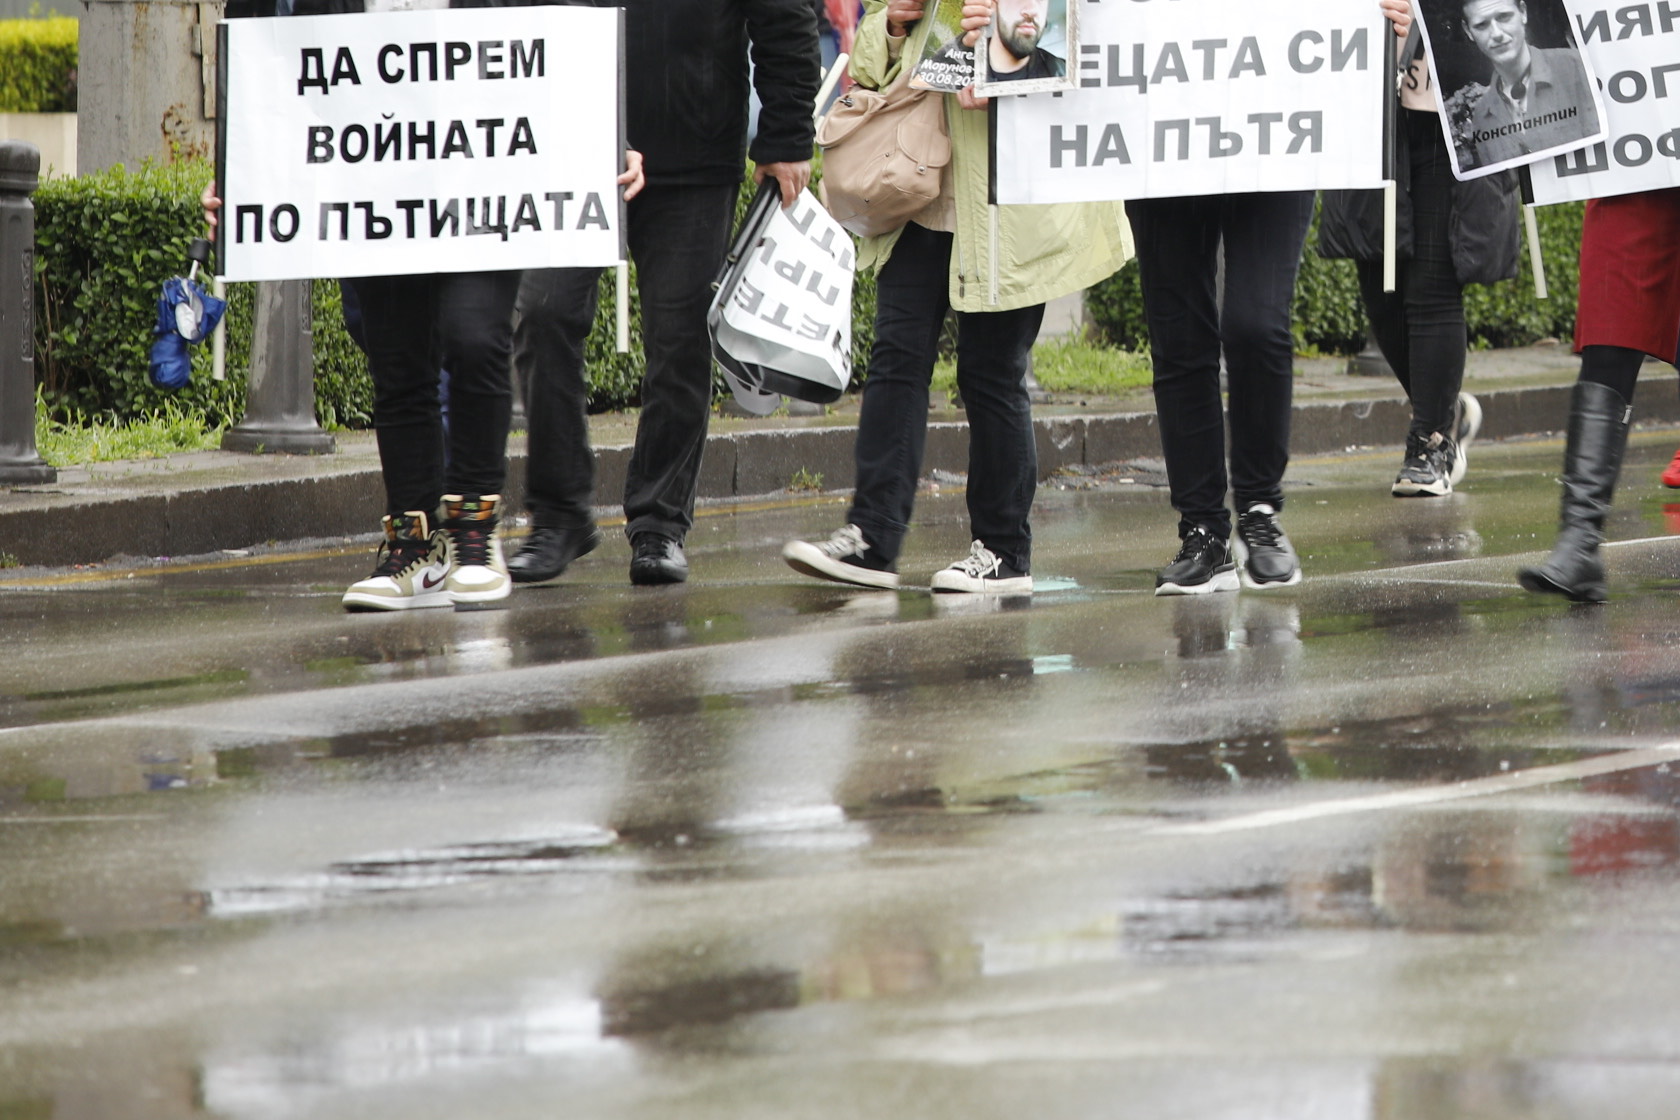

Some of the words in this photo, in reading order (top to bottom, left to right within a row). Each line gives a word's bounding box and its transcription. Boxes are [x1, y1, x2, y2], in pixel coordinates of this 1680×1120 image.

[297, 46, 362, 97] ДА
[377, 38, 545, 85] СПРЕМ
[944, 47, 975, 60] Анге
[1288, 28, 1368, 74] СИ
[307, 113, 538, 165] ВОЙНАТА
[1050, 123, 1131, 168] НА
[1154, 111, 1323, 162] ПЪТЯ
[1471, 106, 1578, 144] Константин
[236, 203, 301, 245] ПО
[319, 191, 610, 243] ПЪТИЩАТА
